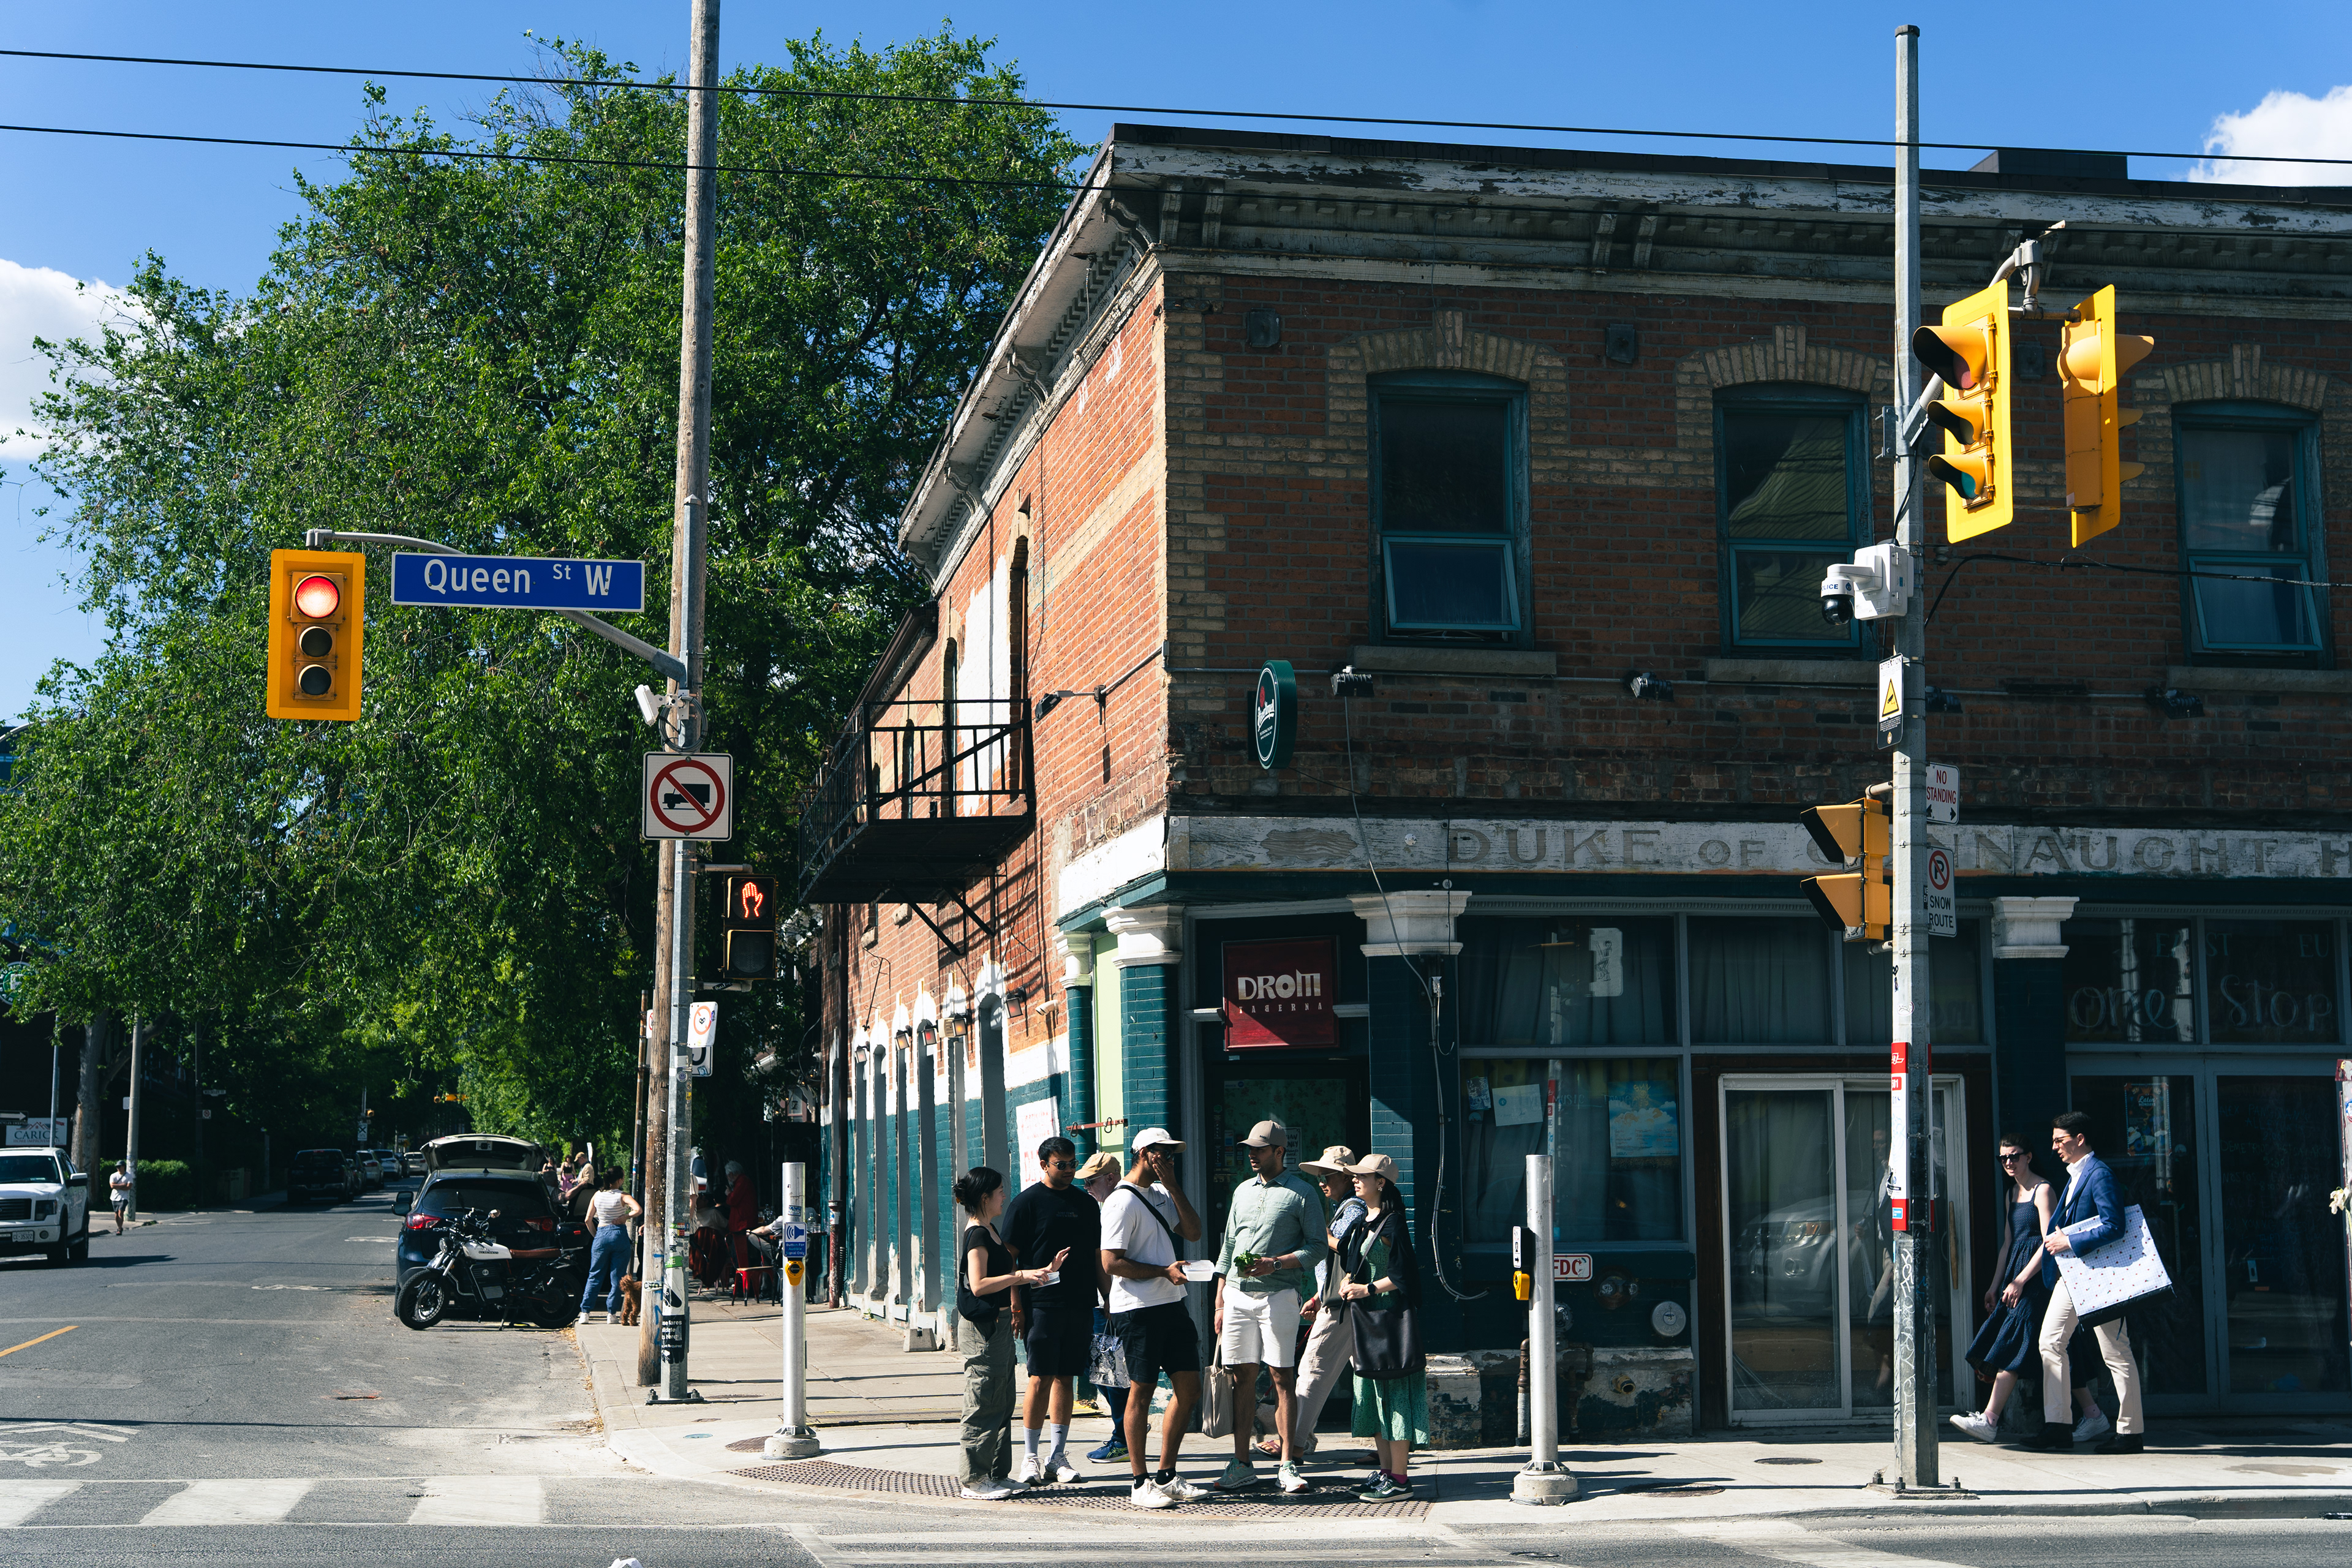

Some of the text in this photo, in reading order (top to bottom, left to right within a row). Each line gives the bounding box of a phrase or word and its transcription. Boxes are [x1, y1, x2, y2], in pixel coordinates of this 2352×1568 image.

[424, 559, 612, 596] Queen St W
[1936, 769, 1947, 785] NO
[1926, 786, 1956, 804] STANDING
[1449, 827, 1660, 865] DUKE
[1698, 839, 1765, 867] OF
[1930, 895, 1951, 910] SNOW
[1929, 913, 1954, 929] ROUTE
[1237, 969, 1321, 1000] DROM
[1238, 1002, 1322, 1014] TABERNA
